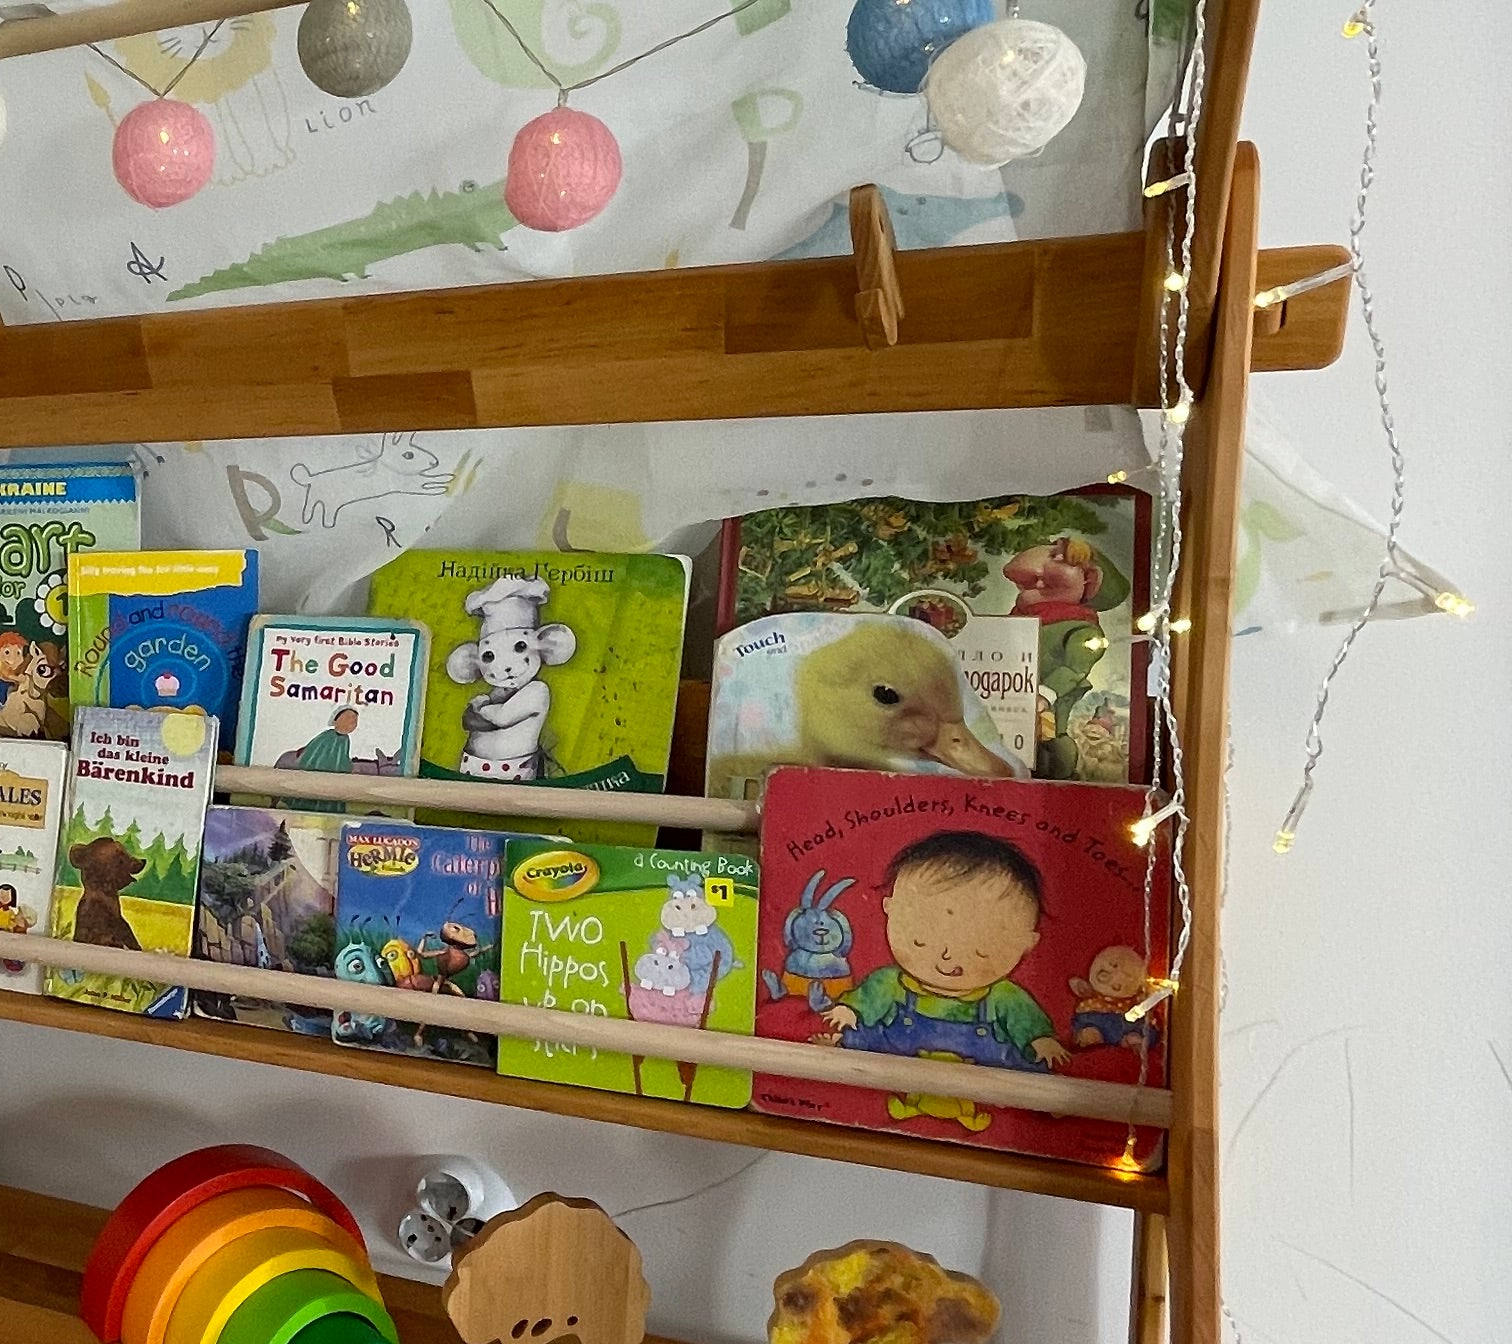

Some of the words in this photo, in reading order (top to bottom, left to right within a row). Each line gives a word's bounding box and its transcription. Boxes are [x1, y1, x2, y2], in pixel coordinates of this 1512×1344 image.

[226, 464, 305, 542] R
[375, 515, 402, 549] R
[128, 600, 164, 626] and
[124, 632, 212, 674] garden
[338, 636, 362, 646] Bible
[733, 631, 786, 659] Touch
[270, 647, 320, 674] The
[328, 652, 396, 678] Good
[269, 675, 394, 707] Samaritan
[964, 666, 1035, 701] одарок
[90, 731, 113, 746] Ich
[117, 734, 140, 748] bin
[97, 747, 122, 761] das
[125, 750, 171, 766] kleine
[76, 758, 196, 790] Bärenkind
[785, 820, 845, 863] Head,
[843, 794, 955, 831] Shoulders,
[963, 793, 1032, 827] Knees
[1035, 818, 1082, 845] and
[525, 861, 586, 880] Crayola
[717, 856, 754, 877] Book
[710, 884, 729, 901] $1
[519, 941, 610, 989] Hippos
